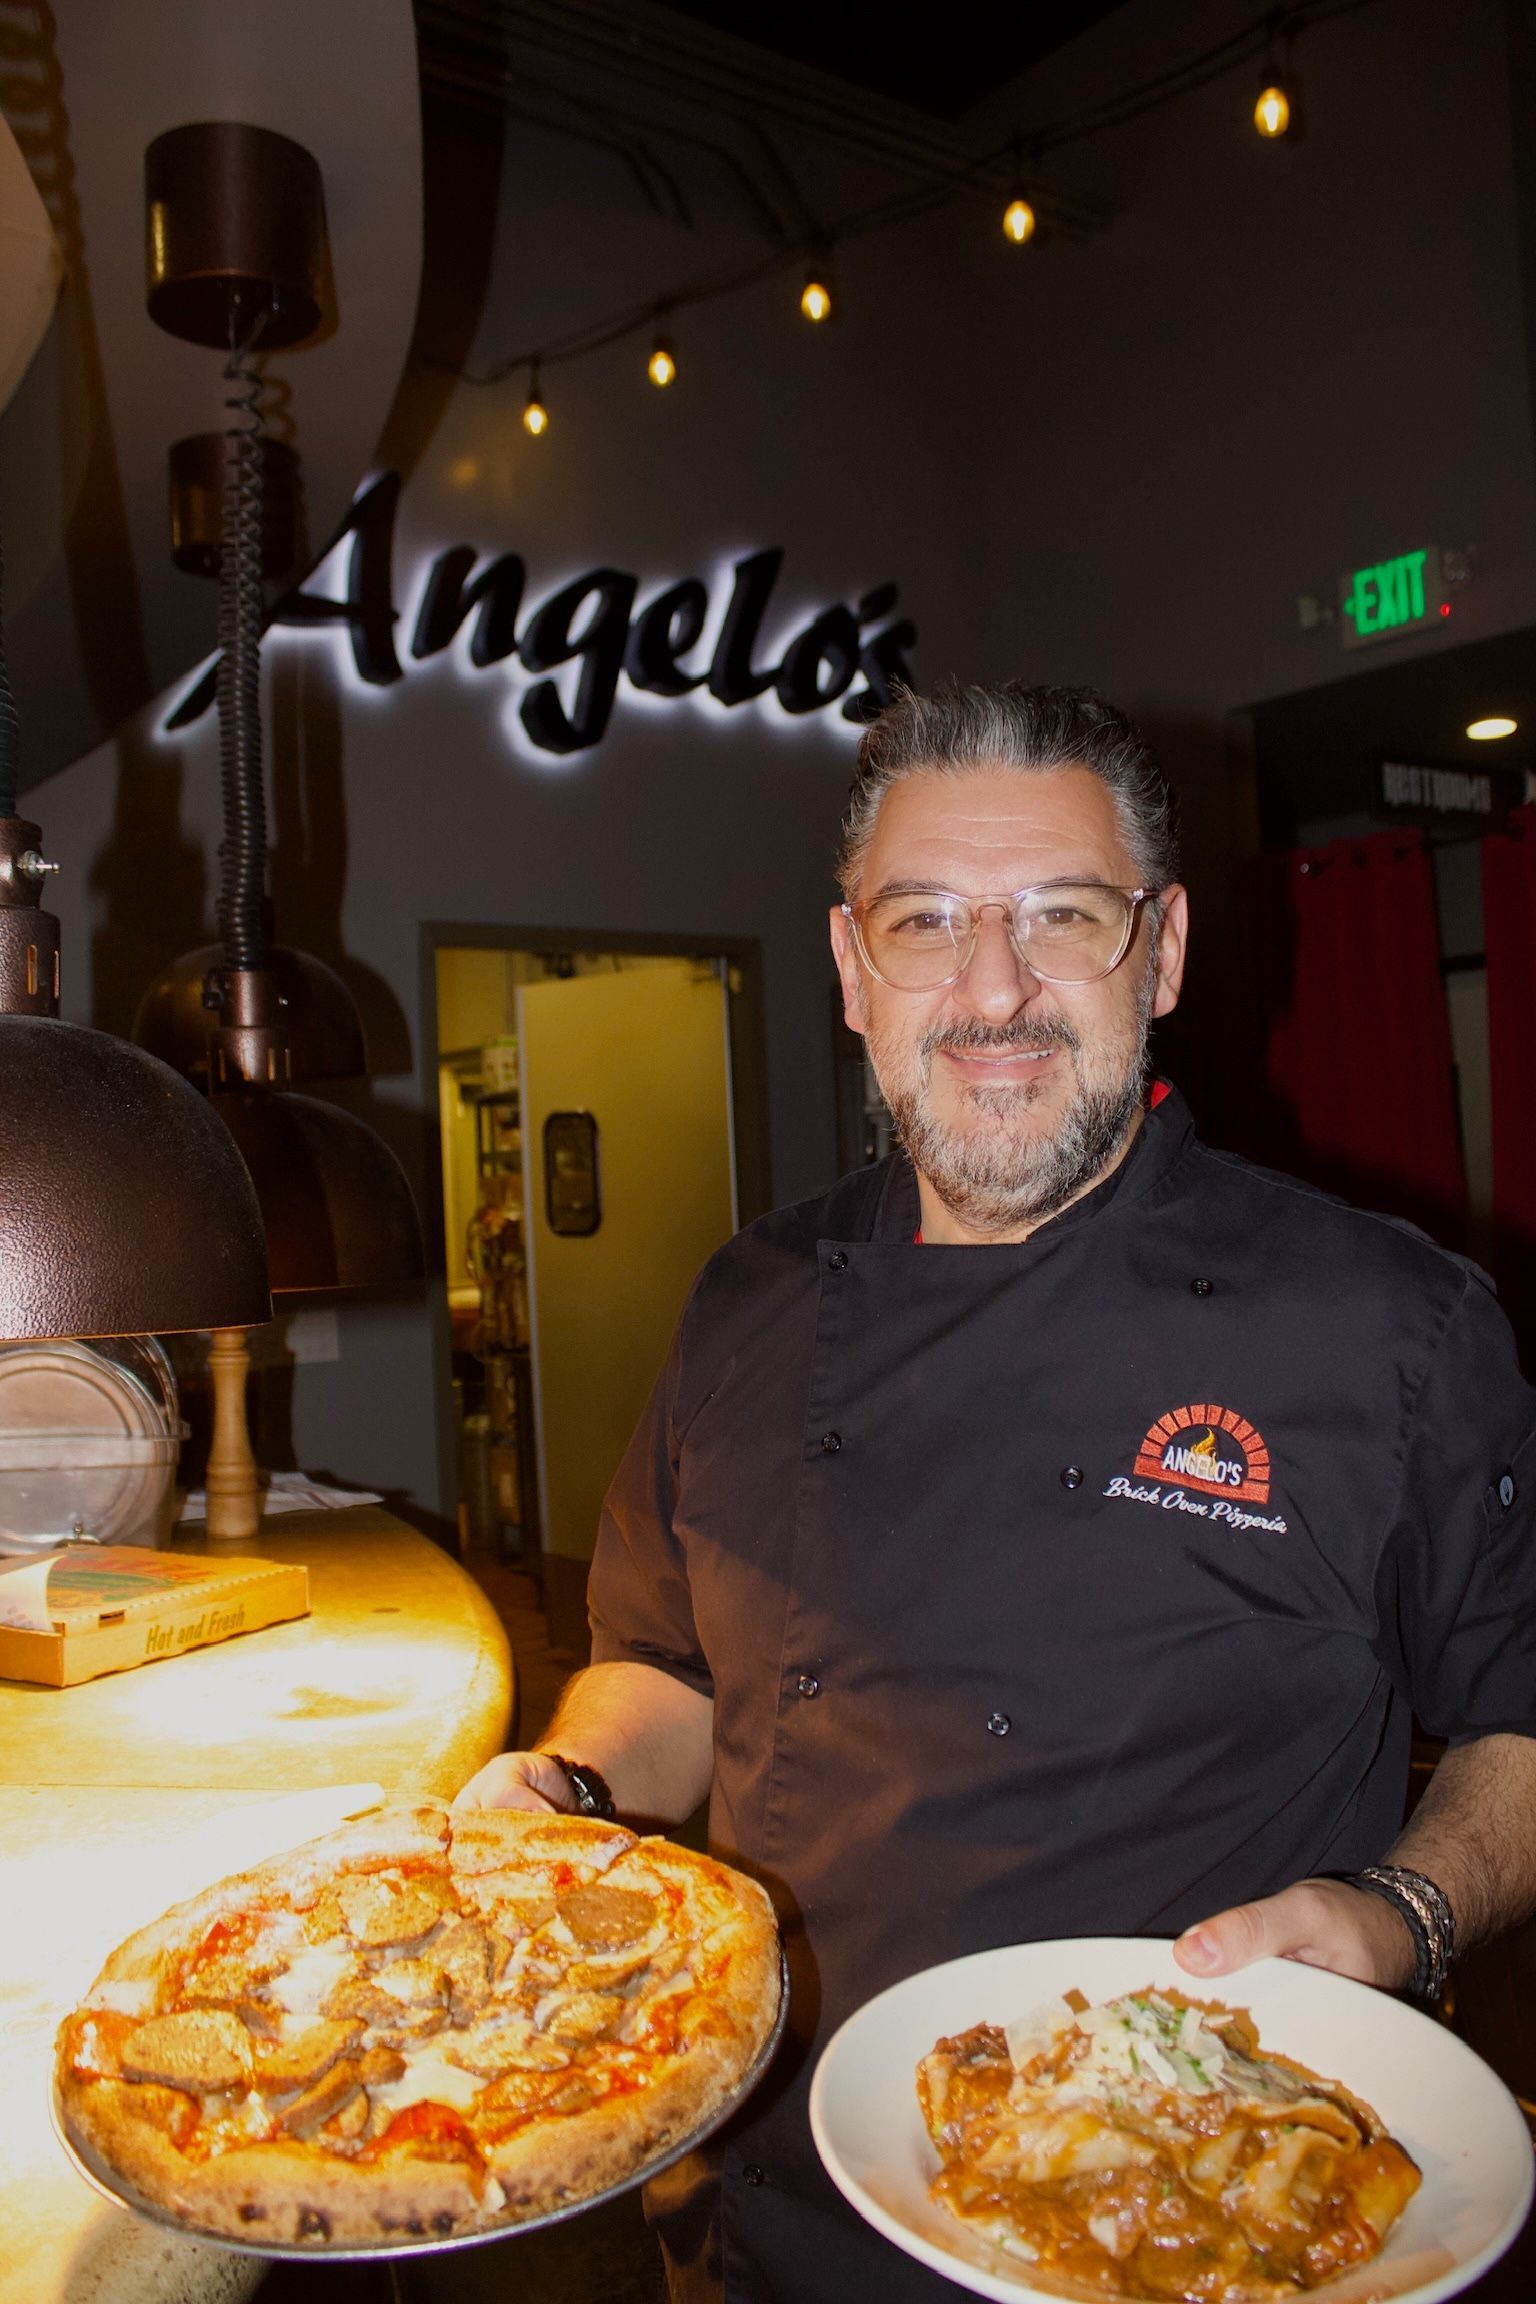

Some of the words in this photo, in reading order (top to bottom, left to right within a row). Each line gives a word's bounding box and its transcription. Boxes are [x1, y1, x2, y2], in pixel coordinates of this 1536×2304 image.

[165, 470, 918, 754] Angelo's
[1353, 549, 1426, 635] EXIT
[1162, 1445, 1243, 1487] ANGELO'S
[1102, 1476, 1161, 1505] Brick
[1161, 1490, 1209, 1517] Oven
[1208, 1501, 1288, 1535] Pizzeria
[145, 1624, 174, 1655] Hot
[177, 1613, 206, 1644] and
[207, 1603, 245, 1636] Fresh
